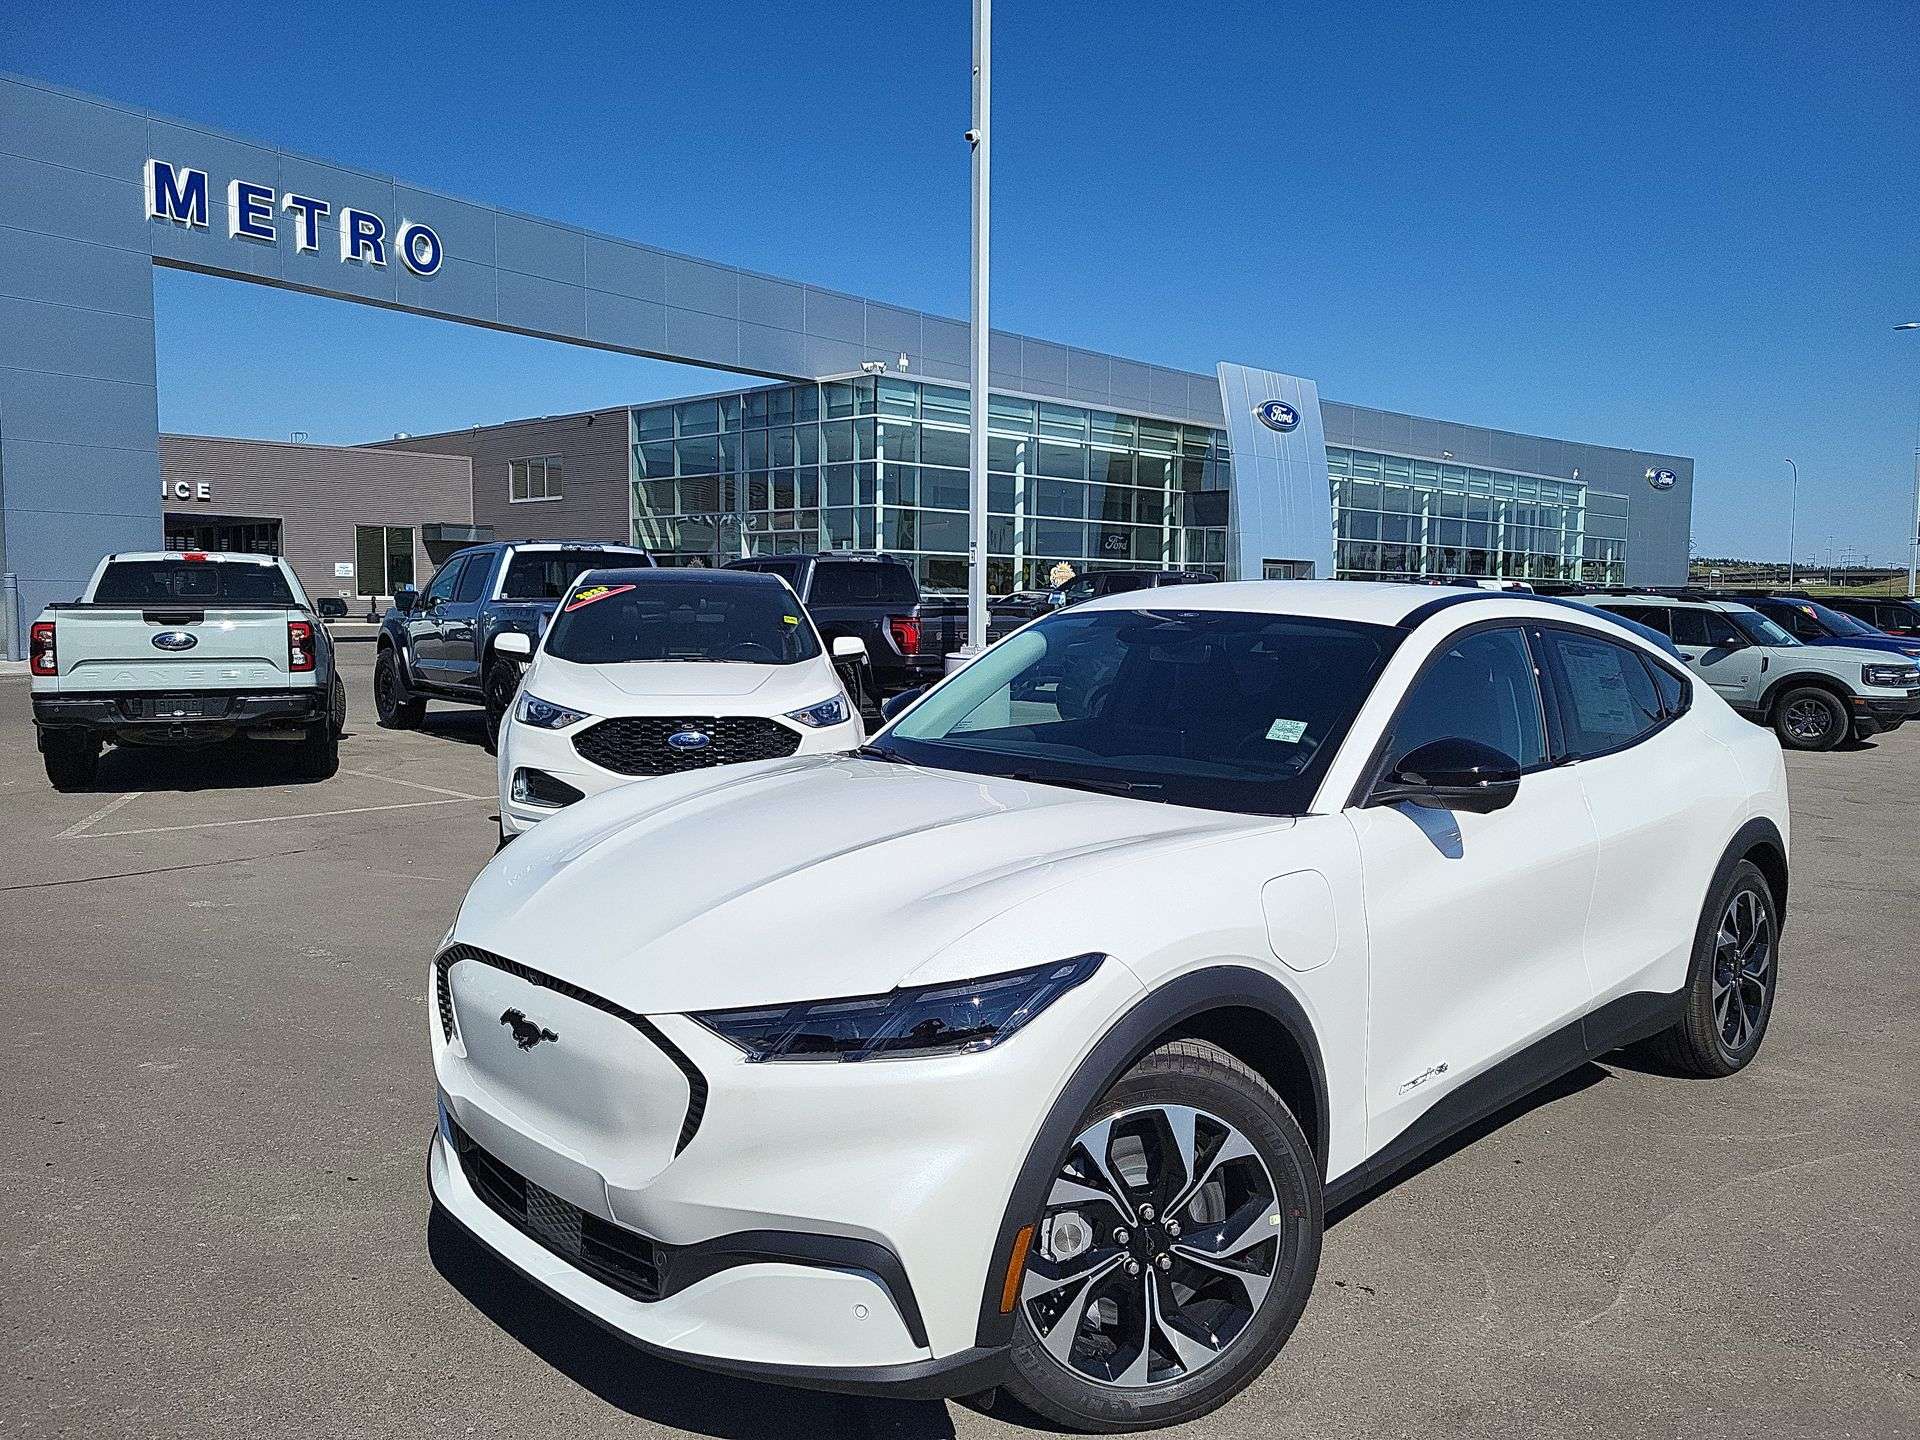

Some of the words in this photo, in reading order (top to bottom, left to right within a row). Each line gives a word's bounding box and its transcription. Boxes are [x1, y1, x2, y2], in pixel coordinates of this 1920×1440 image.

[145, 158, 443, 276] METRO
[1270, 405, 1294, 424] Ford
[1658, 471, 1674, 485] Ford
[1104, 535, 1129, 551] Ford
